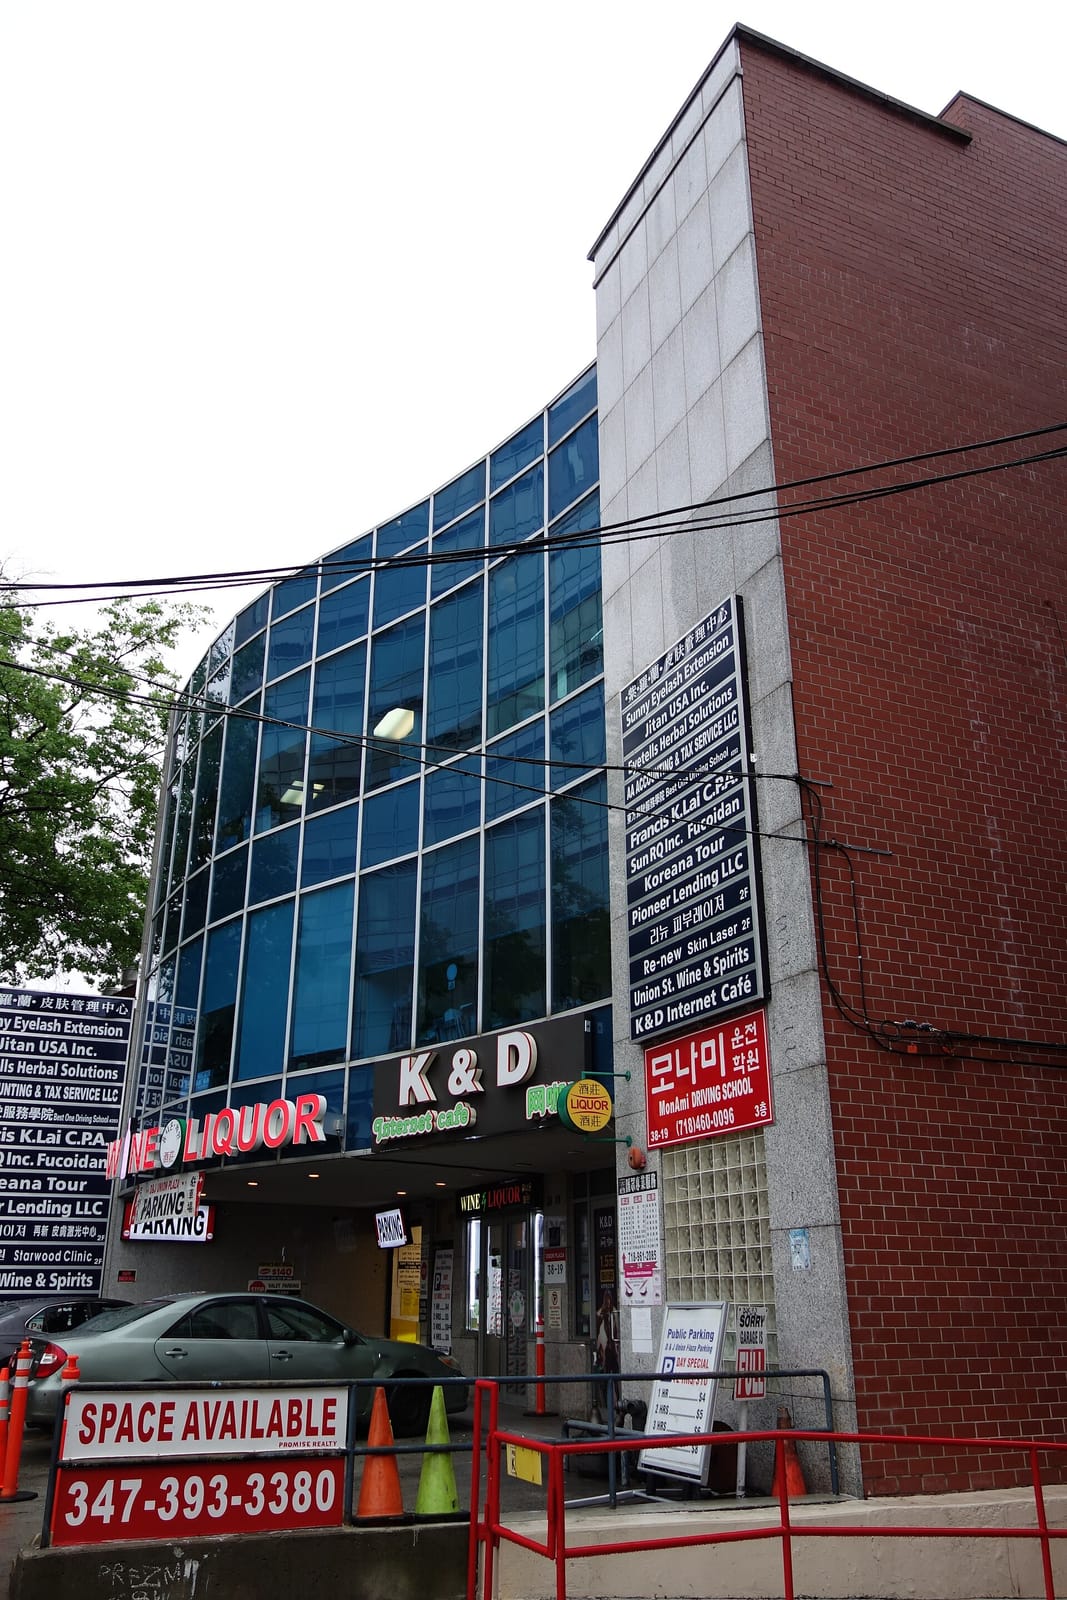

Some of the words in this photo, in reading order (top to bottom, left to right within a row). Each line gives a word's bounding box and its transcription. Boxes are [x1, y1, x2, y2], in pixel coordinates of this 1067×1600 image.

[626, 700, 650, 727] Sunny
[651, 672, 683, 706] Eyelash
[684, 635, 729, 680] Extension
[645, 711, 668, 738] Jitan
[670, 693, 689, 717] USA
[691, 681, 709, 701] Inc.
[660, 718, 687, 751] Herbal
[689, 688, 733, 729] Solutions
[675, 751, 680, 766] &
[681, 741, 694, 760] TAX
[694, 719, 723, 751] SERVICE
[723, 710, 737, 731] LLC
[709, 746, 729, 767] School
[630, 815, 669, 849] Francis
[665, 834, 684, 853] Inc.
[687, 798, 740, 839] Fucoidan
[644, 854, 693, 892] Koreana
[695, 835, 725, 862] Tour
[631, 894, 671, 926] Pioneer
[673, 869, 719, 904] Lending
[721, 852, 744, 878] LLC
[650, 924, 669, 945] 리뉴
[739, 886, 749, 900] 2F
[643, 947, 682, 976] Re-new
[687, 937, 708, 955] Skin
[710, 924, 738, 945] Laser
[741, 917, 751, 931] 2F
[634, 985, 661, 1006] Union
[662, 978, 675, 996] St.
[676, 968, 701, 989] Wine
[703, 961, 711, 978] &
[713, 947, 750, 976] Spirits
[635, 1009, 664, 1034] K&D
[667, 989, 717, 1023] Internet
[721, 974, 752, 1002] Café
[14, 1016, 61, 1033] Eyelash
[63, 1020, 123, 1037] Extension
[39, 1040, 68, 1055] USA
[71, 1043, 98, 1057] Inc.
[651, 1032, 726, 1095] 모나미
[731, 1021, 758, 1049] 운전
[732, 1047, 760, 1075] 학원
[17, 1060, 59, 1076] Herbal
[60, 1063, 119, 1080] Solutions
[399, 1051, 437, 1106] K
[447, 1048, 485, 1096] &
[497, 1030, 538, 1087] D
[34, 1085, 41, 1098] &
[44, 1085, 62, 1099] TAX
[63, 1086, 100, 1101] SERVICE
[102, 1088, 119, 1102] LLC
[570, 1098, 610, 1111] LIQUOR
[658, 1093, 689, 1117] MonAmi
[691, 1084, 721, 1108] DRIVING
[722, 1076, 753, 1100] SCHOOL
[54, 1112, 64, 1121] Best
[65, 1113, 75, 1122] One
[76, 1113, 92, 1124] Driving
[182, 1094, 328, 1163] LIQUOR
[373, 1111, 432, 1144] Internet
[436, 1101, 471, 1130] cafe
[650, 1127, 669, 1142] 38-19
[675, 1107, 735, 1136] (718)460-0096
[754, 1101, 767, 1118] 3층
[20, 1129, 62, 1144] K.Lai
[65, 1130, 108, 1146] C.P.A.
[7, 1152, 34, 1166] Inc.
[37, 1153, 106, 1168] Fucoidan
[47, 1177, 88, 1191] Tour
[7, 1199, 72, 1218] Lending
[75, 1201, 103, 1215] LLC
[140, 1191, 185, 1220] PARKING
[460, 1193, 480, 1213] WINE
[487, 1185, 521, 1209] LIQUOR
[377, 1212, 404, 1243] PARKING
[13, 1249, 61, 1262] Starwood
[63, 1250, 93, 1262] Clinic
[547, 1264, 564, 1275] 38-19
[0, 1272, 32, 1287] Wine
[36, 1272, 46, 1287] &
[49, 1272, 94, 1291] Spirits
[667, 1328, 687, 1339] Public
[688, 1328, 715, 1342] Parking
[740, 1314, 765, 1328] SORRY
[740, 1330, 758, 1344] GARAGE
[758, 1330, 764, 1344] IS
[676, 1357, 687, 1367] DAY
[687, 1358, 709, 1369] SPECIAL
[737, 1351, 764, 1396] FULL
[78, 1401, 177, 1446] SPACE
[181, 1398, 339, 1442] AVAILABLE
[659, 1404, 669, 1415] HRS
[657, 1421, 667, 1431] HRS
[312, 1440, 338, 1448] REALTY
[64, 1469, 338, 1527] 347-393-3380
